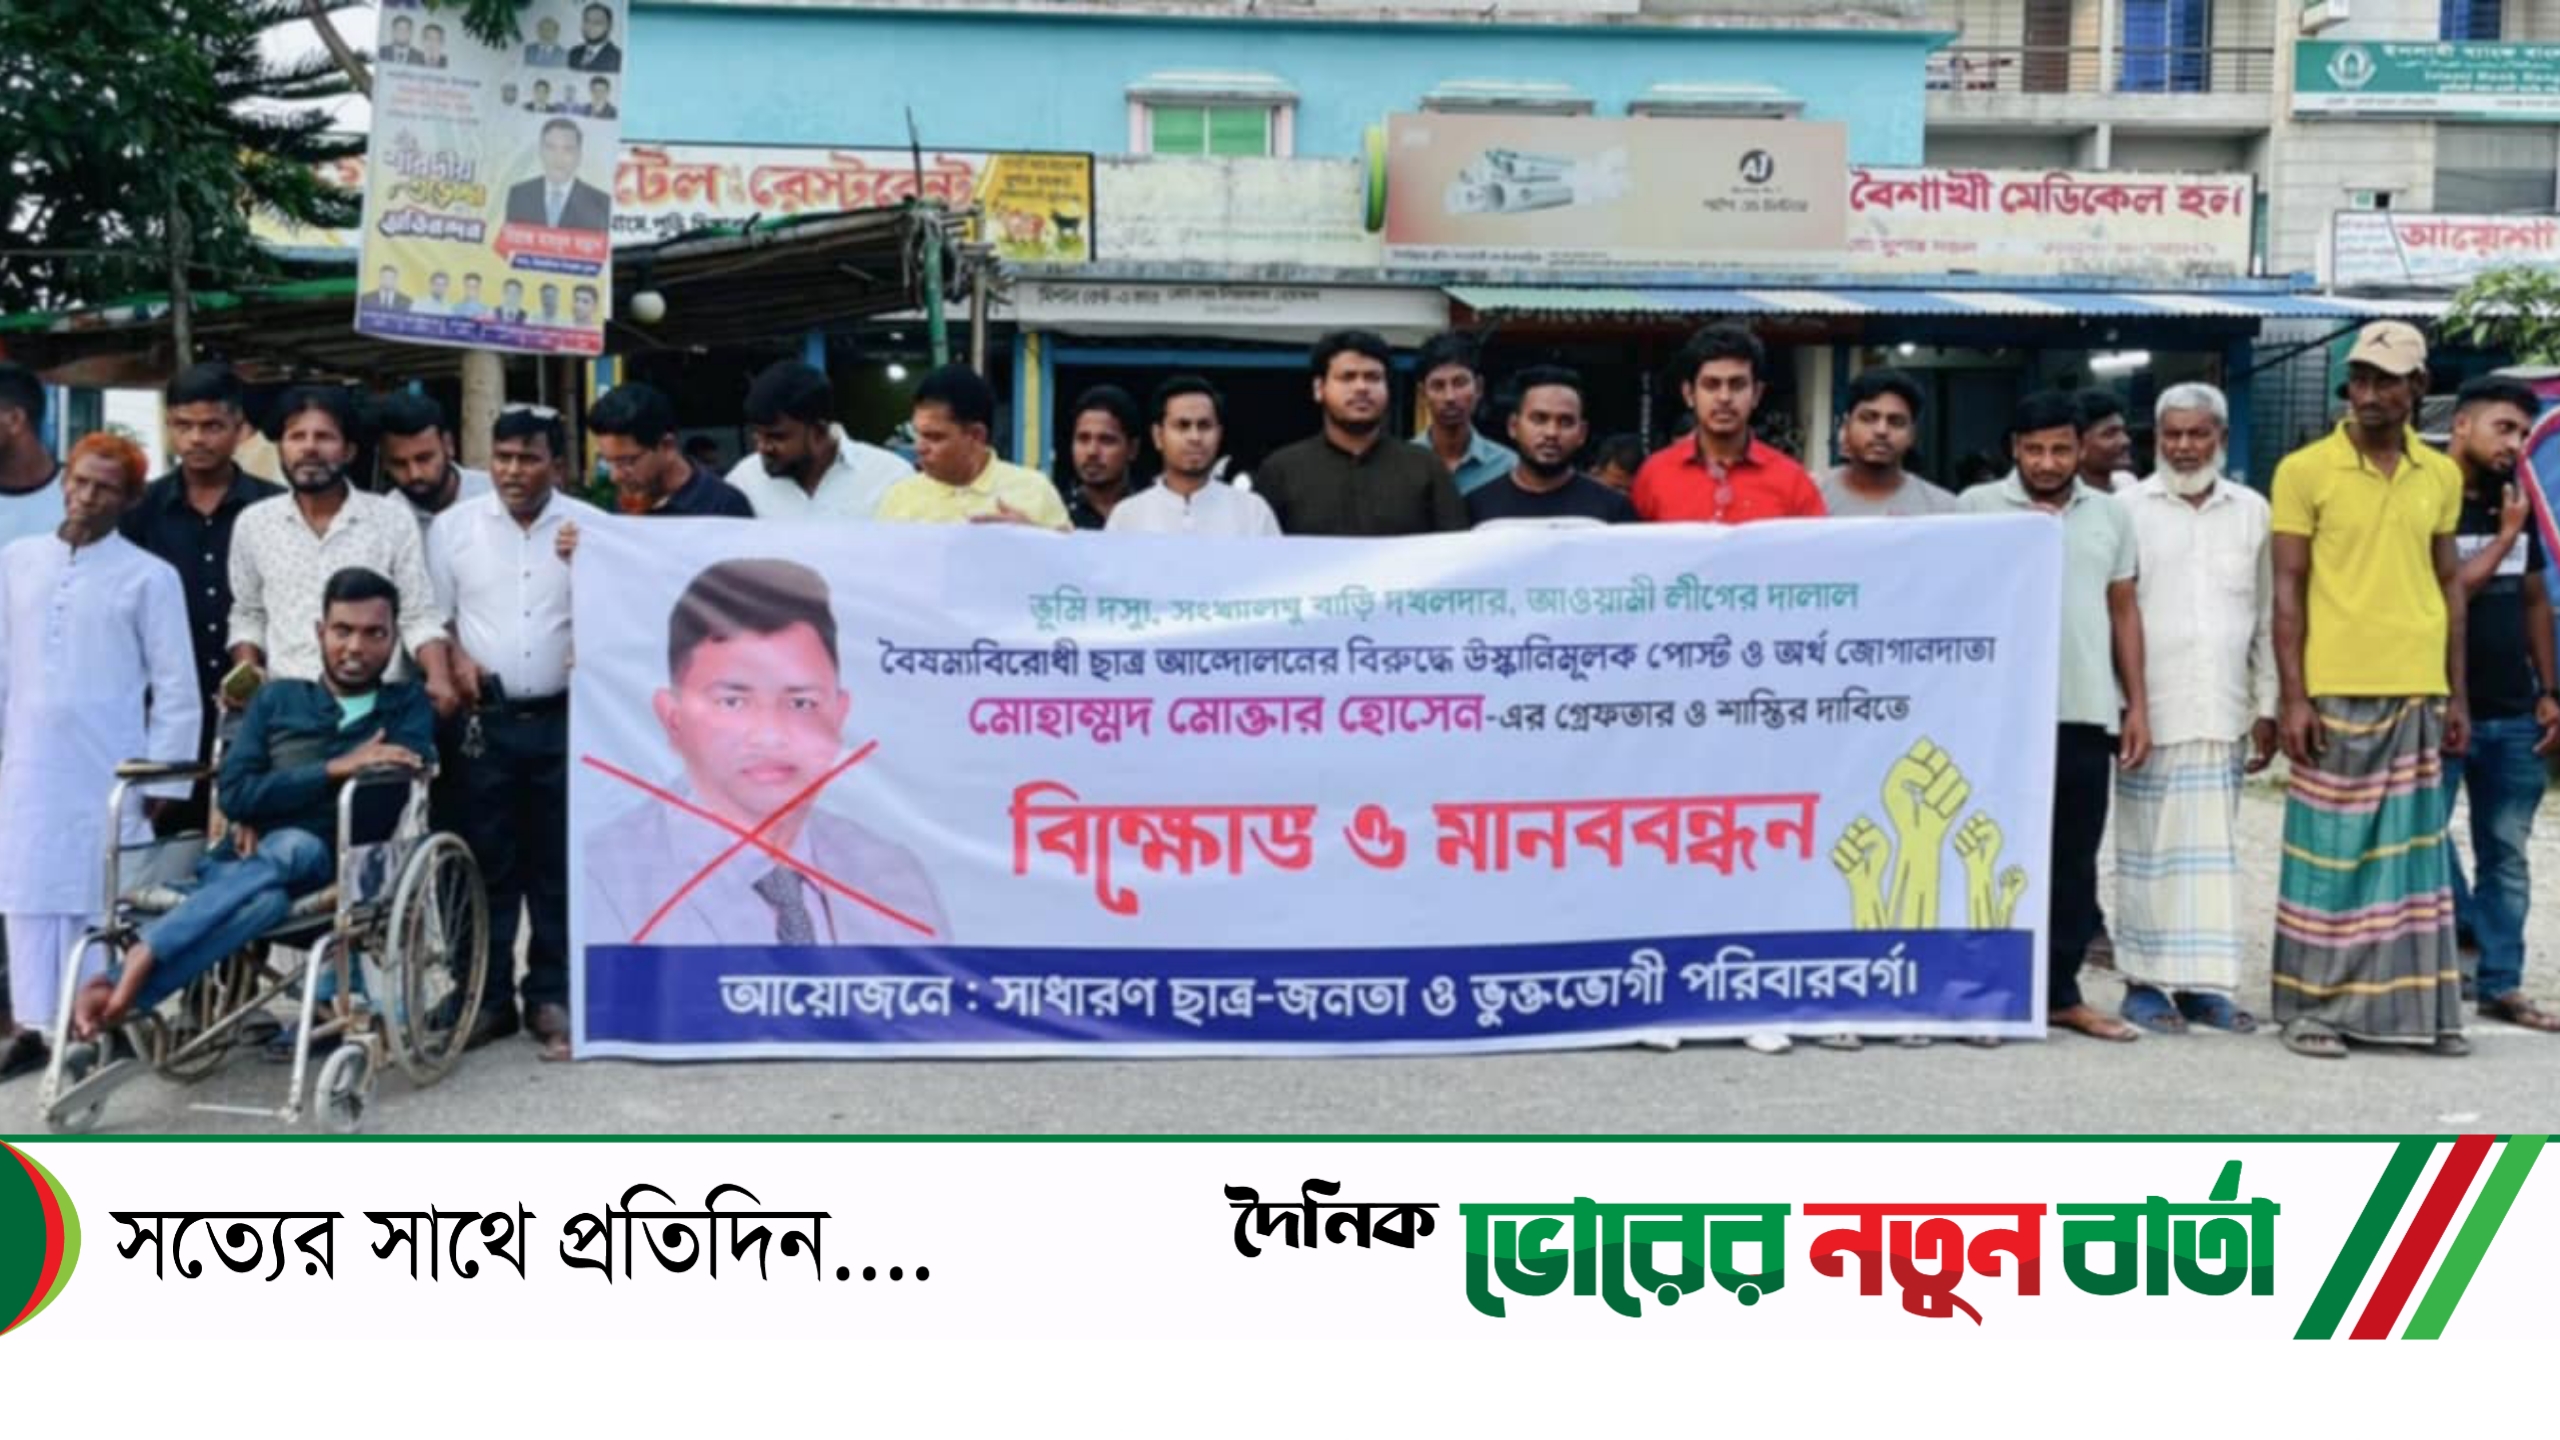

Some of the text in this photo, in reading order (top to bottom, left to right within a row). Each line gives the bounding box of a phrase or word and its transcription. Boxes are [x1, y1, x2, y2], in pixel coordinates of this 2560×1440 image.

[1849, 170, 1992, 213] বৈশাখী
[2001, 172, 2166, 216] মেডিকেল
[1028, 582, 1088, 632] ভূমি
[1526, 573, 1656, 616] আওয়ামী
[1664, 572, 1758, 611] লীগের
[1766, 581, 1860, 610] দালাল
[876, 634, 1082, 680] বৈষম্যবিরোধী
[1087, 645, 1147, 684] ছাত্র
[1154, 645, 1340, 677] আন্দোলনের
[1345, 633, 1455, 676] বিরুদ্ধে
[1646, 633, 1733, 672] পোস্ট
[1740, 640, 1766, 670] ও
[1773, 628, 1830, 668] অর্থ
[1834, 633, 1998, 669] জোগানদাতা
[967, 696, 1155, 744] মোহাম্মদ
[1167, 696, 1326, 738] মোক্তার
[1554, 700, 1677, 732] গ্রেফতার
[1684, 699, 1708, 728] ও
[1716, 686, 1809, 731] শাস্তির
[1815, 684, 1912, 725] দাবিতে
[1008, 780, 1820, 916] বিক্ষোভ ও মানববন্ধন
[719, 974, 953, 1020] আয়োজনে
[993, 974, 1158, 1017] সাধারণ
[1421, 977, 1457, 1016] ও
[1471, 947, 1666, 1026] ভুক্তভোগী
